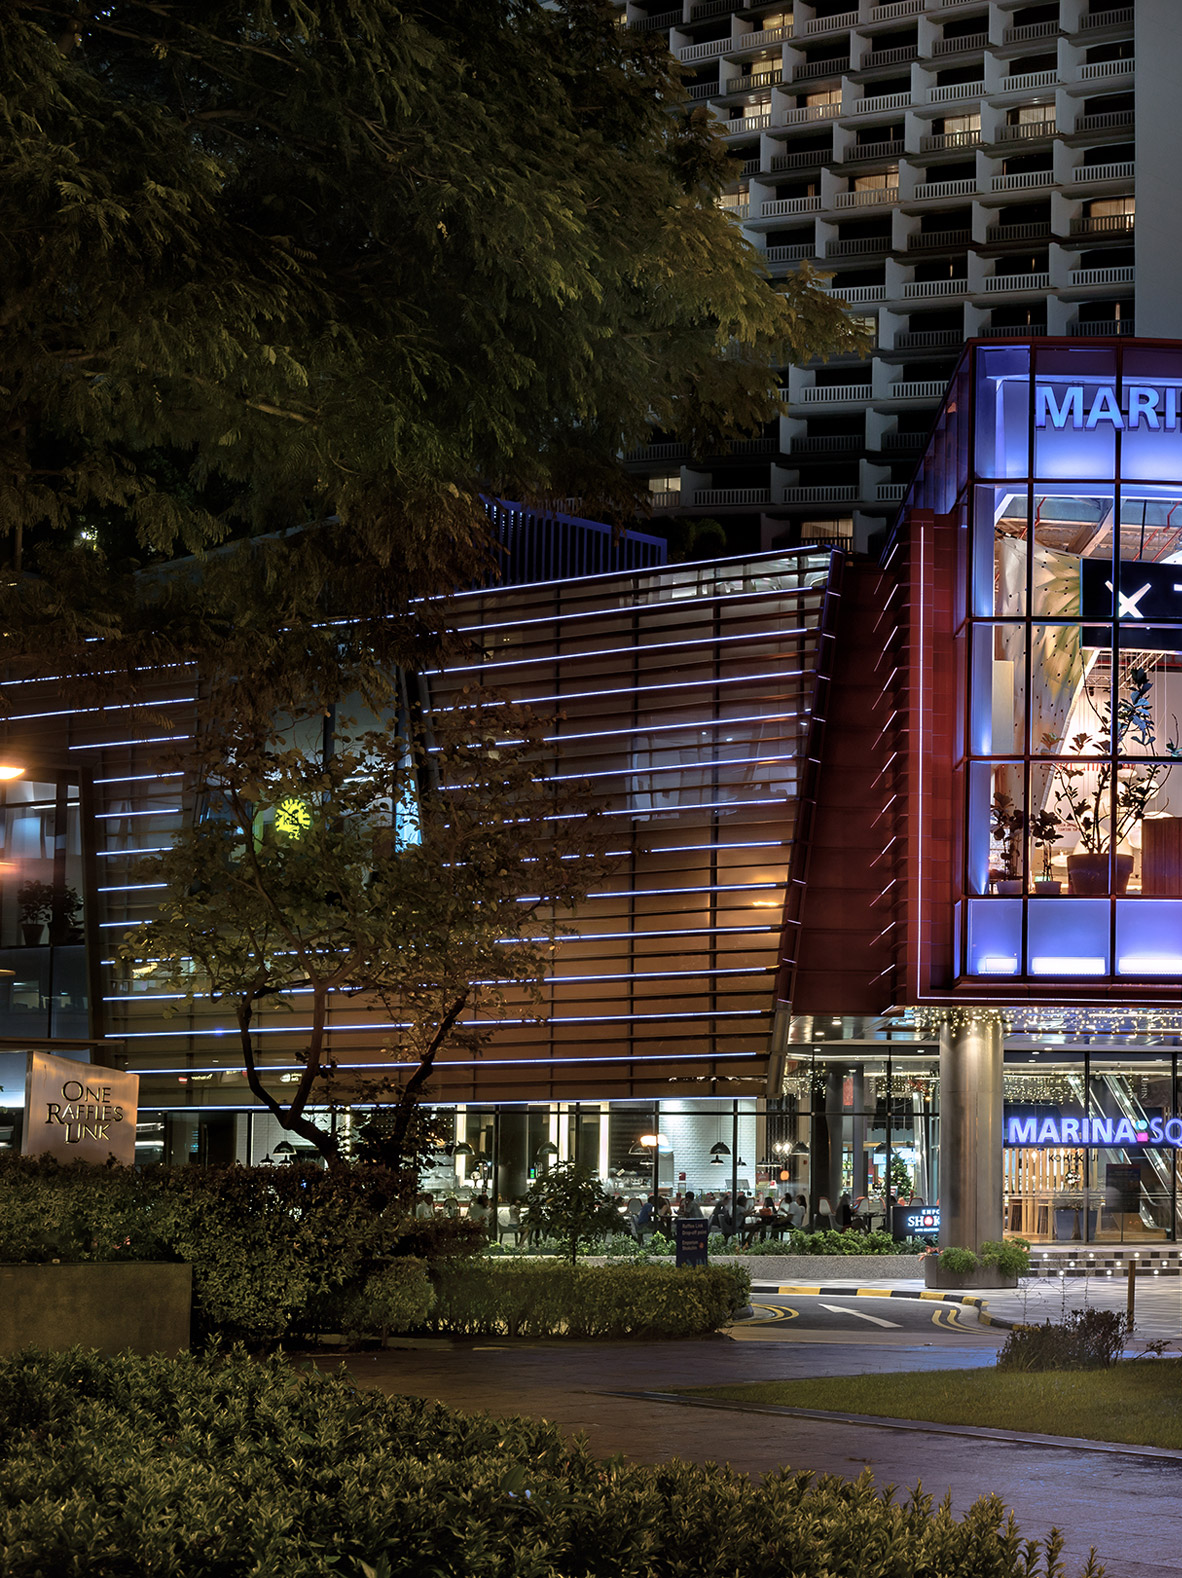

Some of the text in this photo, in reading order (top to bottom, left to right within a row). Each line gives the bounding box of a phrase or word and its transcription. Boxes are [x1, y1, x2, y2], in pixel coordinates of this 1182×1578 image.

[61, 1080, 111, 1103] ONE
[45, 1102, 124, 1125] RAFFLES
[64, 1122, 111, 1145] LINK
[1008, 1118, 1137, 1144] MARINA
